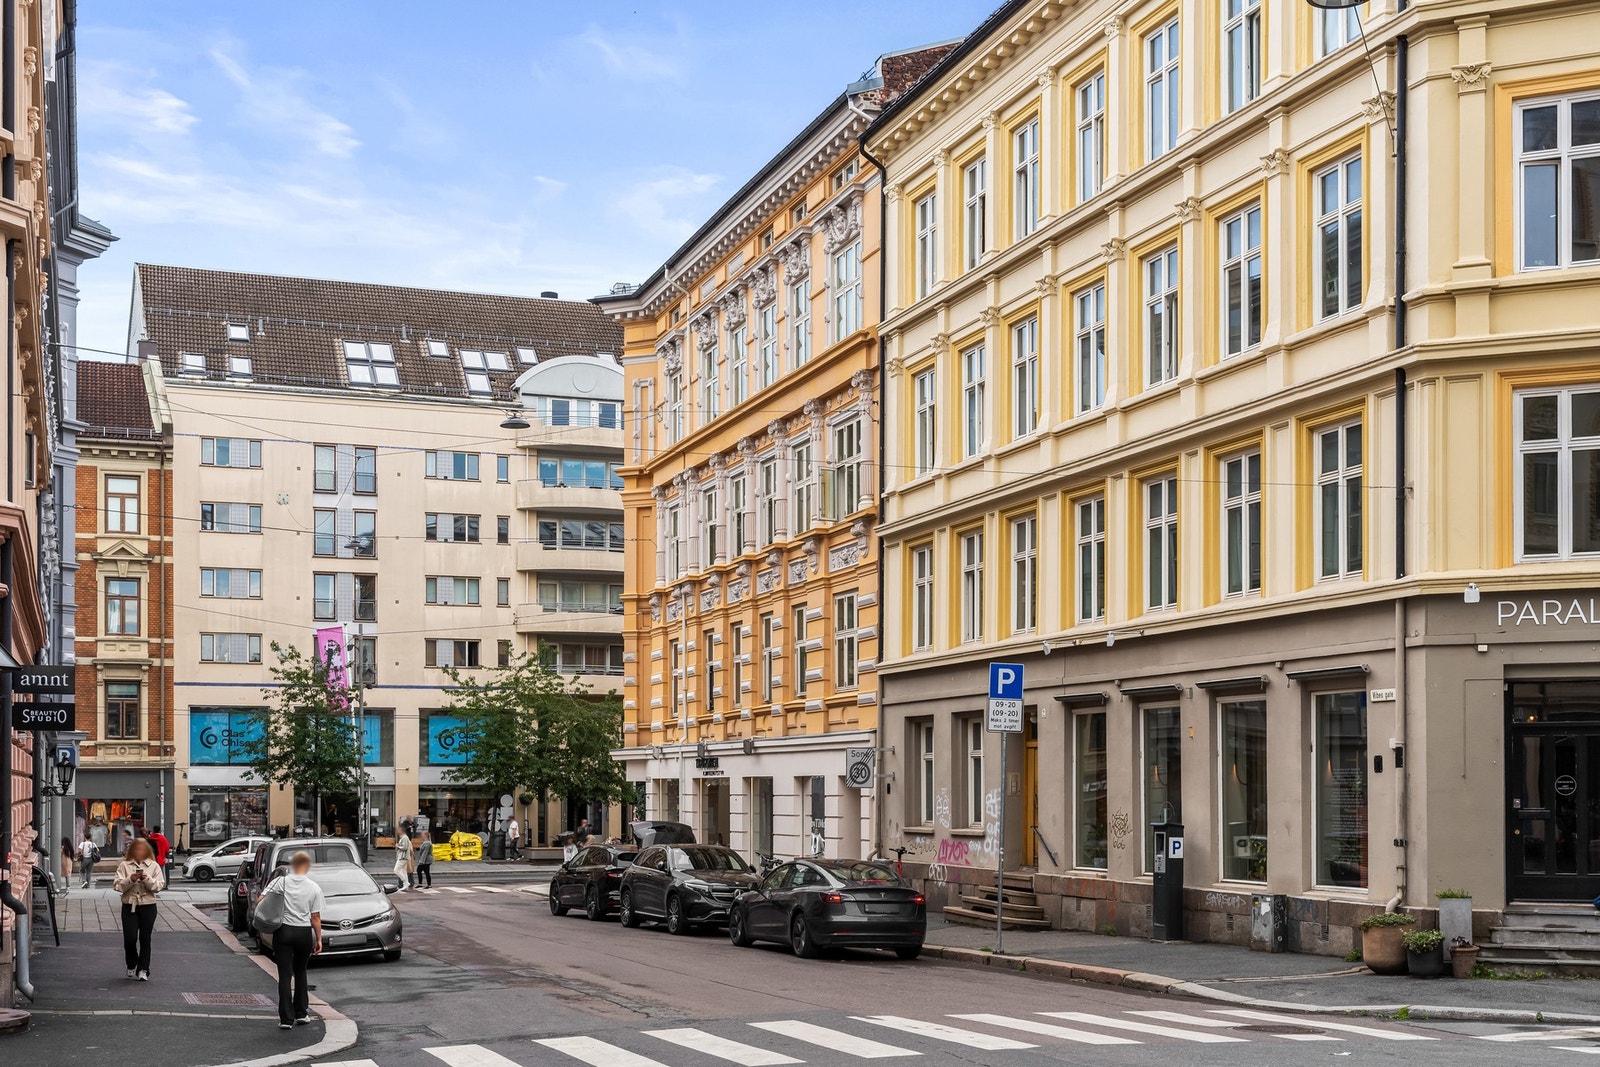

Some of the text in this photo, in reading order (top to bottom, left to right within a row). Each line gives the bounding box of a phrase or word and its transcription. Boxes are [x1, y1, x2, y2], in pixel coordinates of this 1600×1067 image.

[20, 673, 69, 687] amnt
[997, 668, 1016, 694] P
[1172, 840, 1182, 855] P
